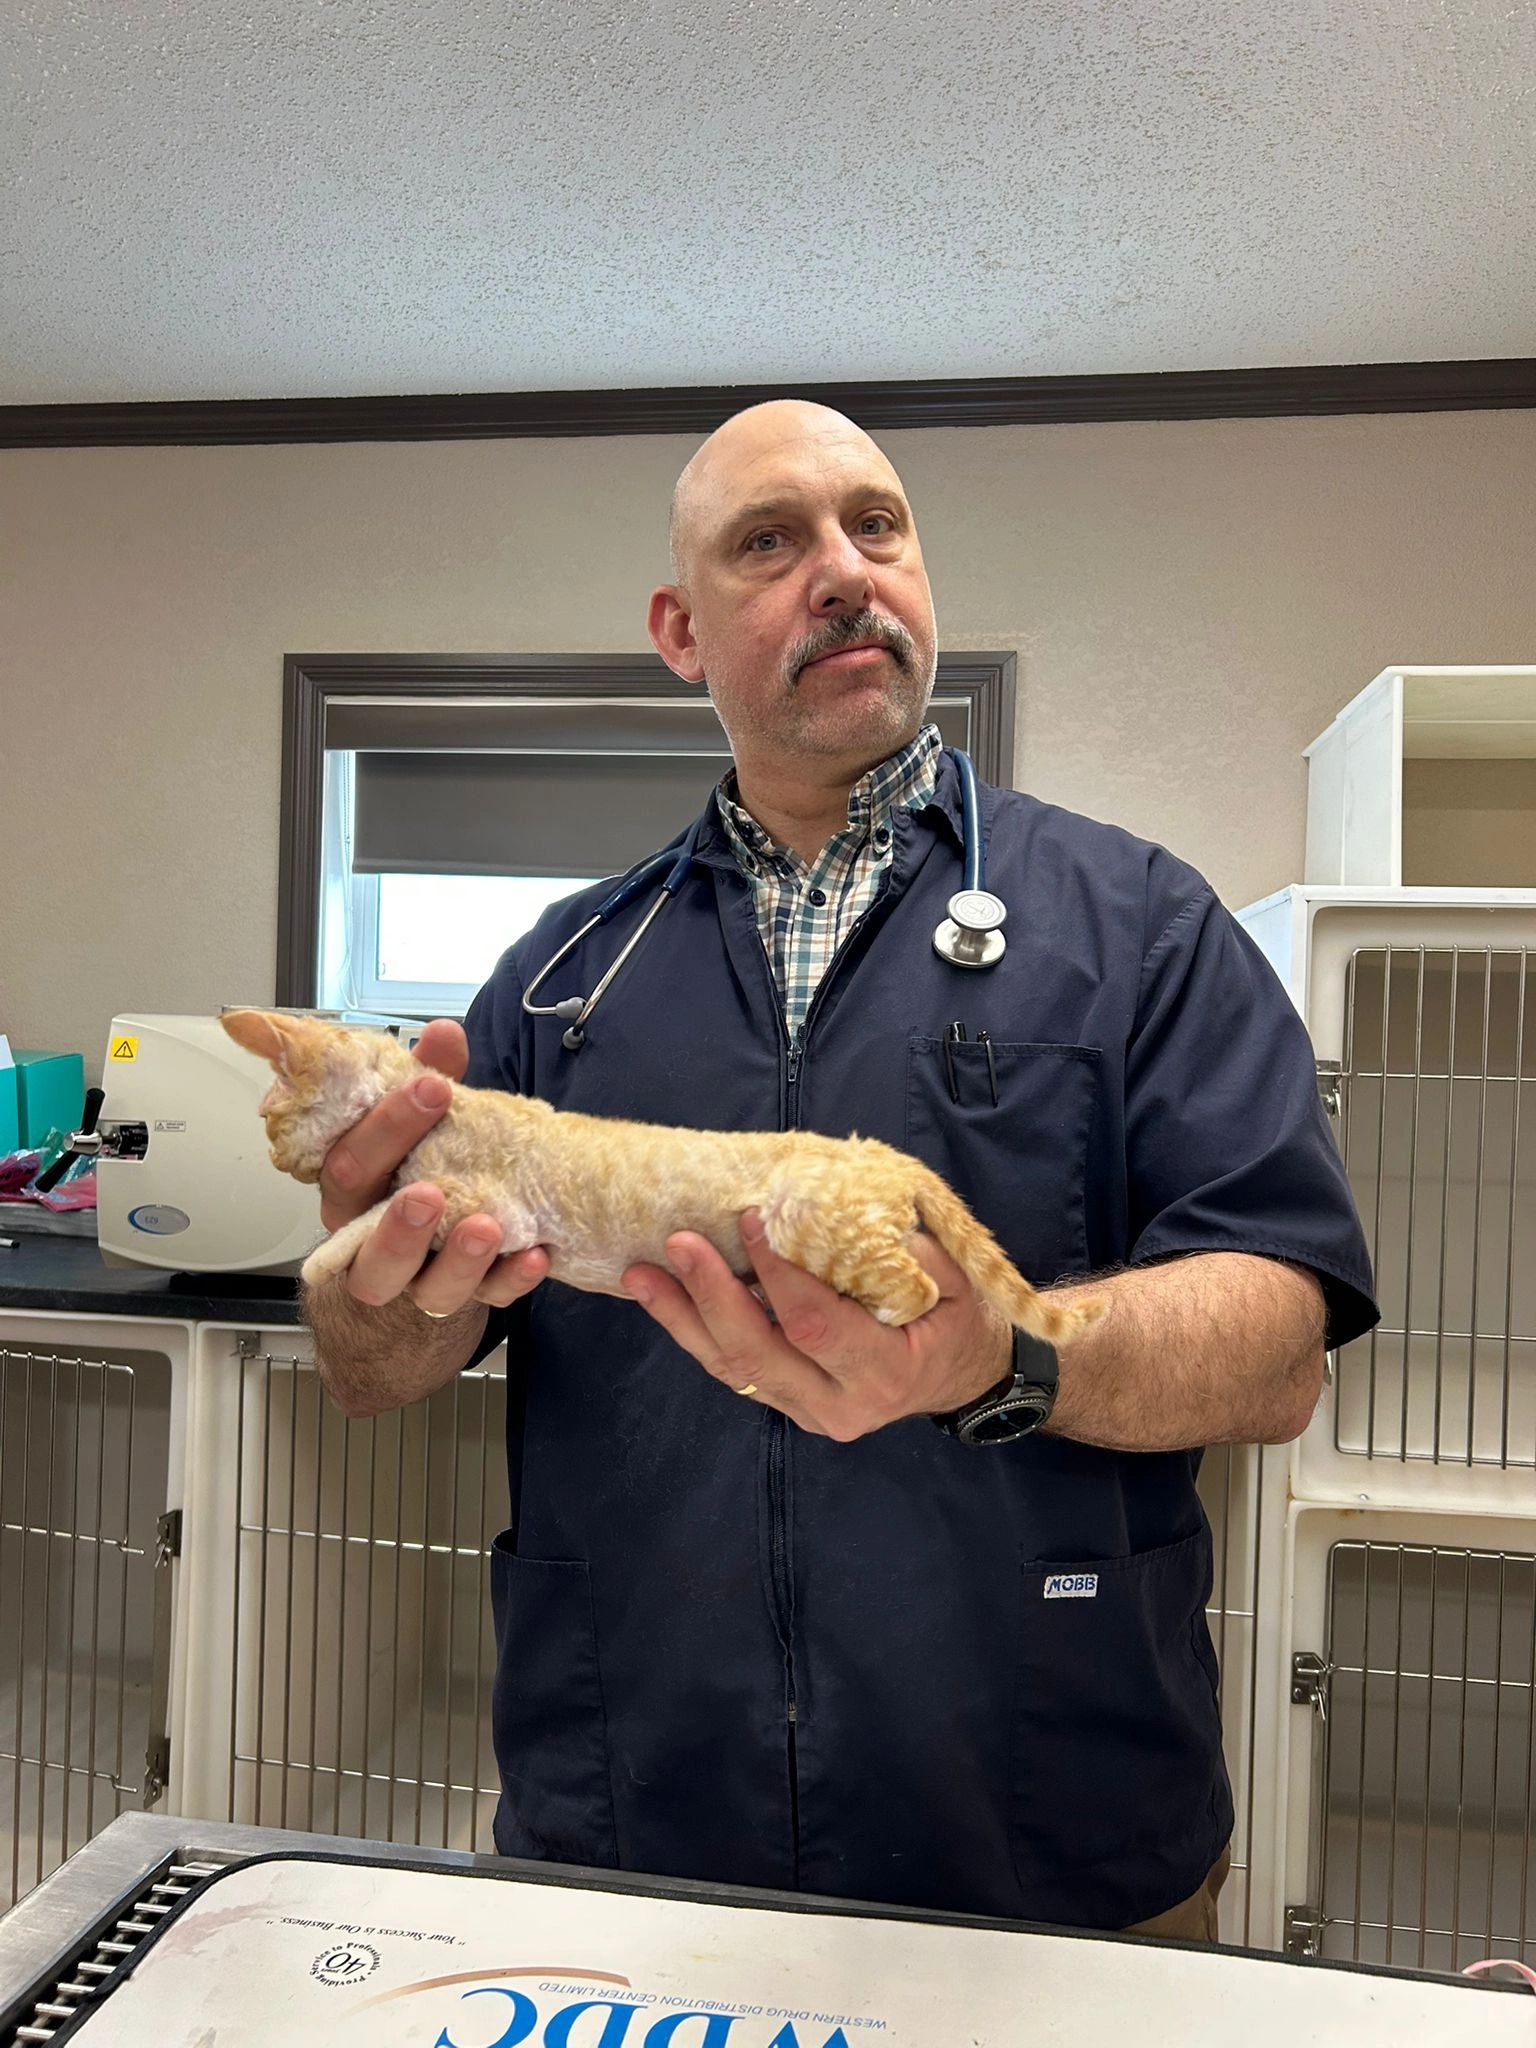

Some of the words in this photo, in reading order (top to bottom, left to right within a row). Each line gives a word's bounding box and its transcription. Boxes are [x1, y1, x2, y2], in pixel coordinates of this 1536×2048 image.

[1047, 1577, 1096, 1594] MOBB
[335, 1924, 361, 1934] Our
[363, 1926, 375, 1935] is
[377, 1928, 427, 1941] Success
[309, 1950, 331, 1976] Service
[325, 1952, 367, 1976] 40
[315, 1974, 366, 1987] Providing
[538, 1982, 594, 1996] LIMITED
[599, 1990, 657, 2003] CENTER
[660, 1995, 763, 2015] DISTRIBUTION
[766, 2008, 810, 2020] DRUG
[812, 2014, 887, 2029] WESTERN
